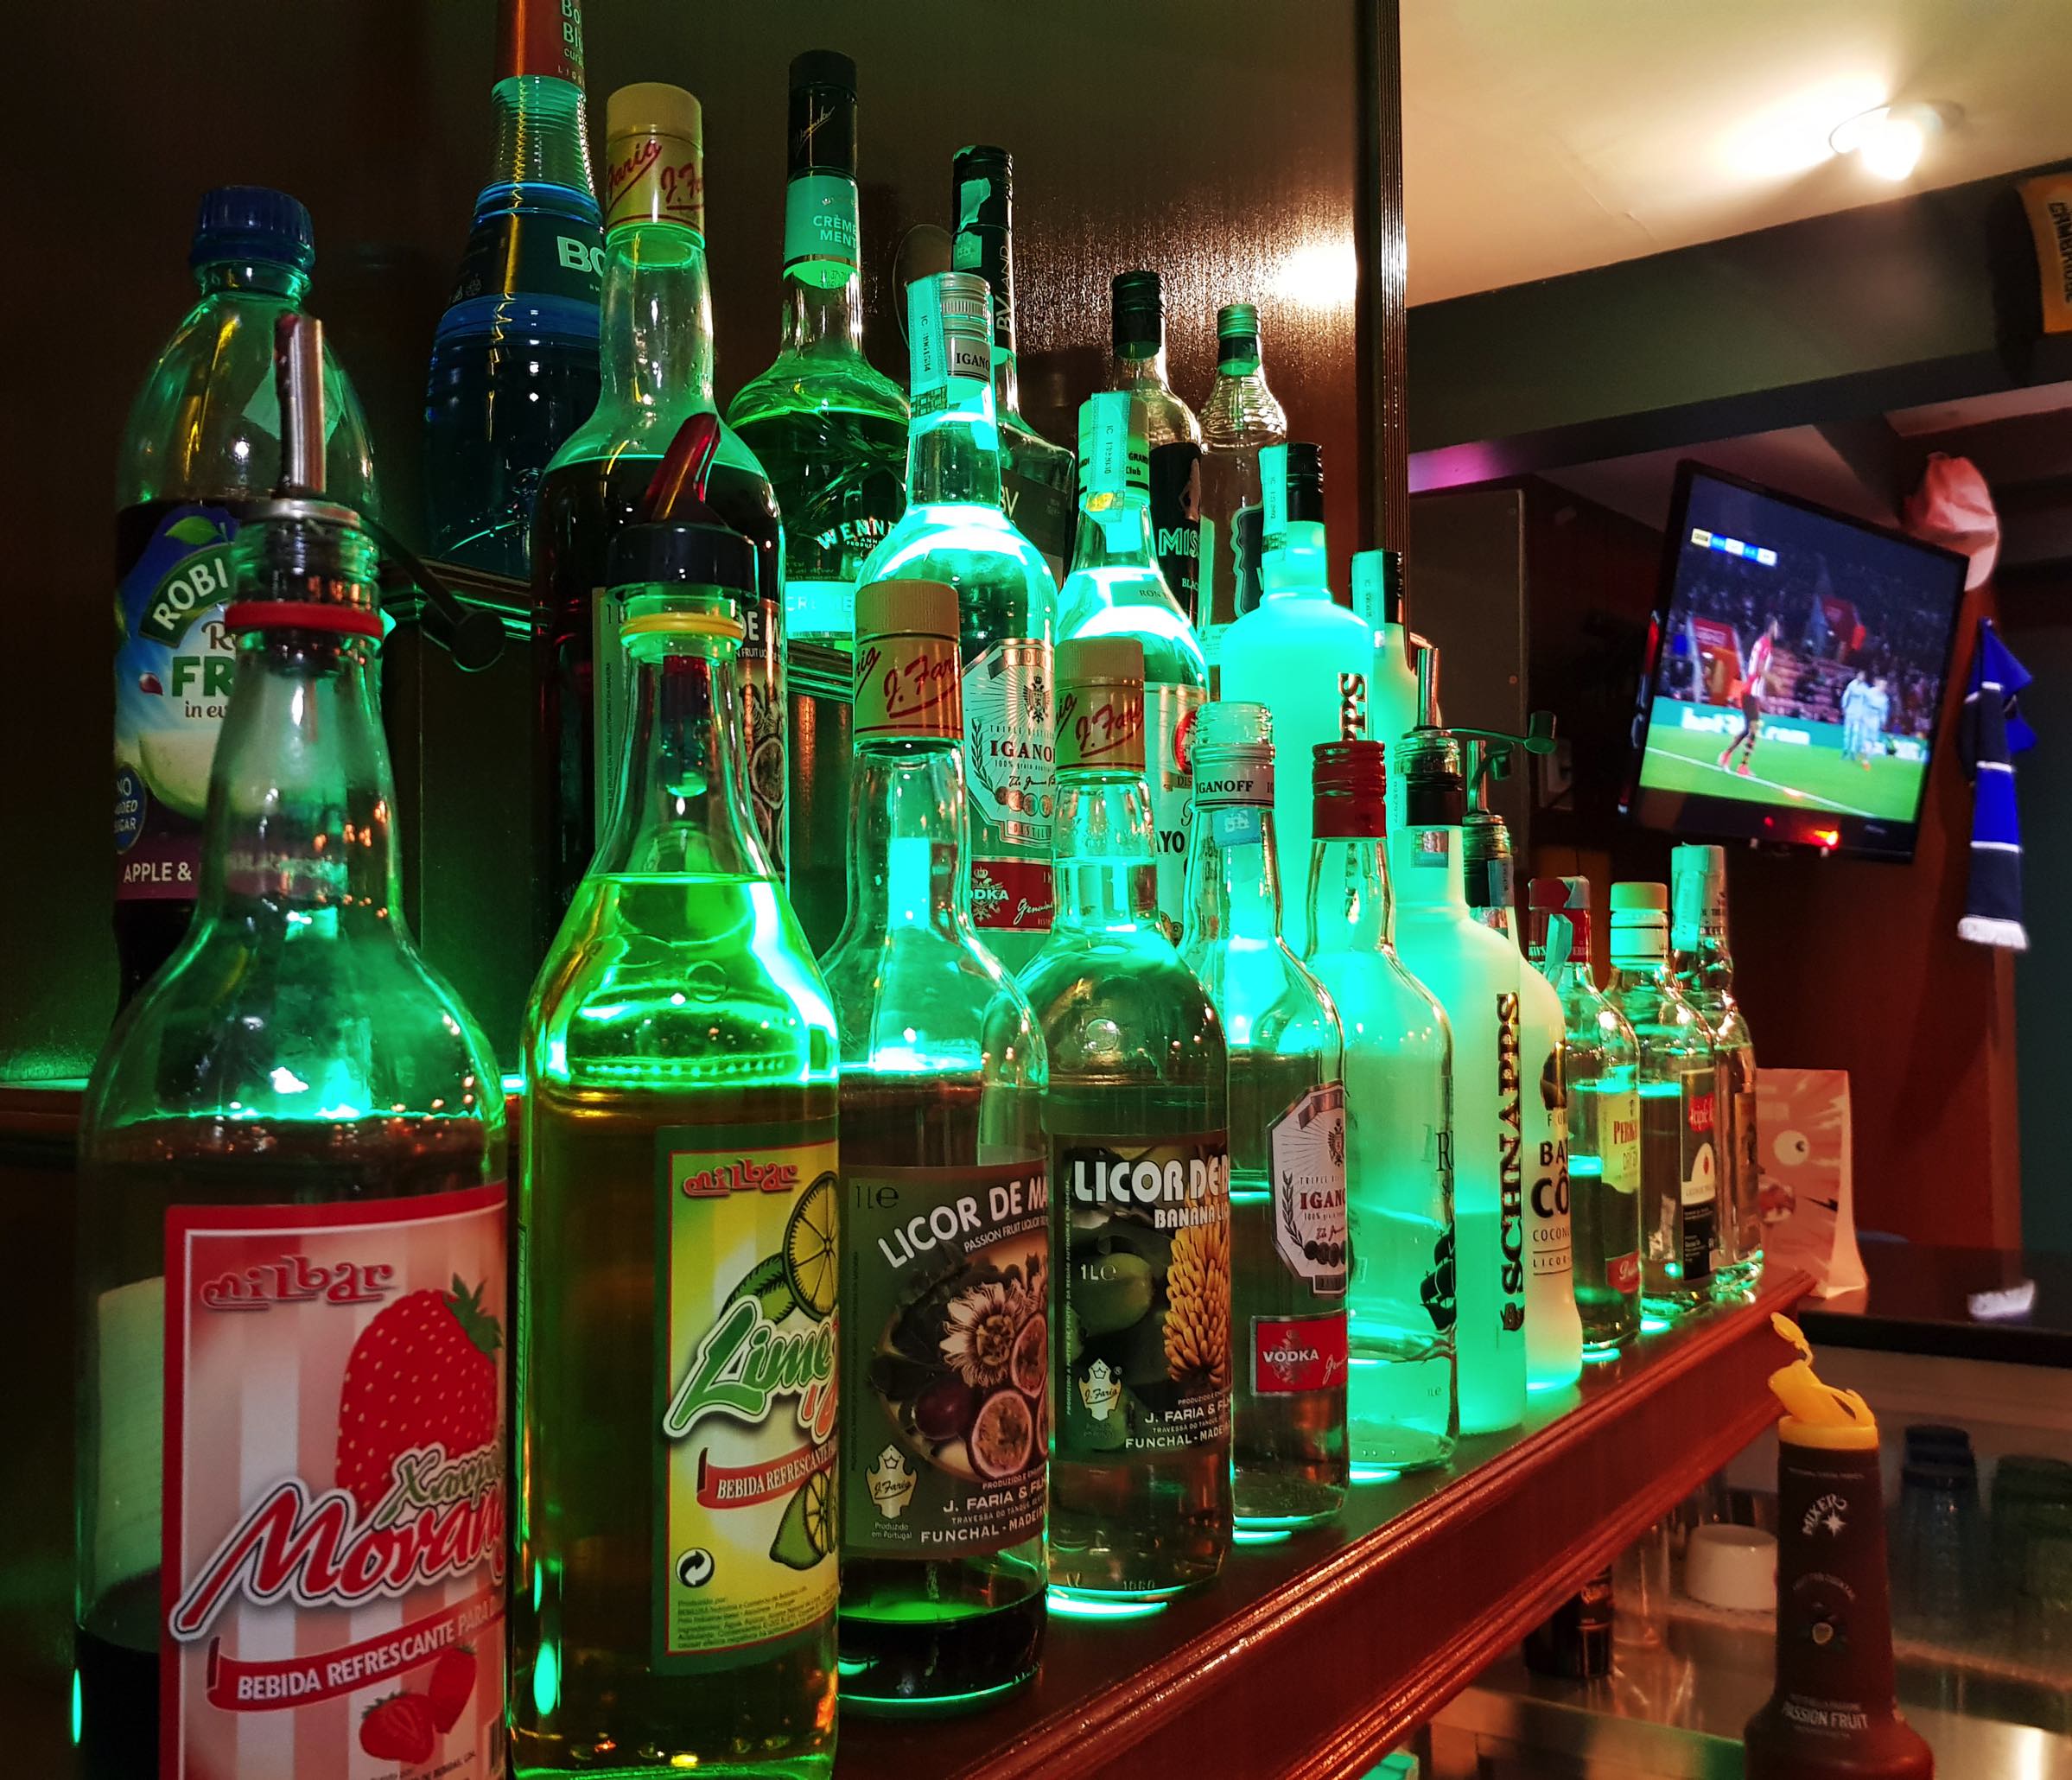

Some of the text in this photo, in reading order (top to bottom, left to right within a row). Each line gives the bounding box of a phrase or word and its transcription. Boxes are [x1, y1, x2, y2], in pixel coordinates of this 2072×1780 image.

[152, 557, 229, 631] ROBI
[1139, 588, 1161, 598] RON
[184, 701, 203, 718] in
[124, 861, 193, 883] APPLE &
[1496, 993, 1524, 1295] SCHNAPPS
[1074, 1154, 1220, 1203] LICOR DE
[877, 1196, 982, 1269] LICOR
[988, 1179, 1023, 1222] DE
[1154, 1205, 1216, 1230] BANANA
[963, 1227, 1002, 1253] PASSION
[1002, 1220, 1021, 1238] FRUIT
[669, 1300, 834, 1430] Lime
[1262, 1348, 1319, 1363] VODKA
[1093, 1388, 1118, 1399] Faria
[1144, 1412, 1159, 1424] J.
[1164, 1406, 1204, 1423] FARIA
[1208, 1403, 1216, 1414] &
[1125, 1434, 1192, 1449] FUNCHAL
[716, 1473, 766, 1501] BEBIDA
[881, 1478, 912, 1494] Faria
[942, 1499, 960, 1513] J.
[967, 1491, 1014, 1511] FARIA
[1018, 1485, 1028, 1499] &
[874, 1522, 910, 1532] Produzido
[951, 1512, 995, 1525] TRAVESSA
[995, 1509, 1007, 1518] DO
[882, 1530, 912, 1542] Portugal
[920, 1524, 1000, 1544] FUNCHAL
[237, 1668, 323, 1701] BEBIDA
[326, 1618, 456, 1688] REFRESCANTE
[1830, 1712, 1868, 1729] FRUIT
